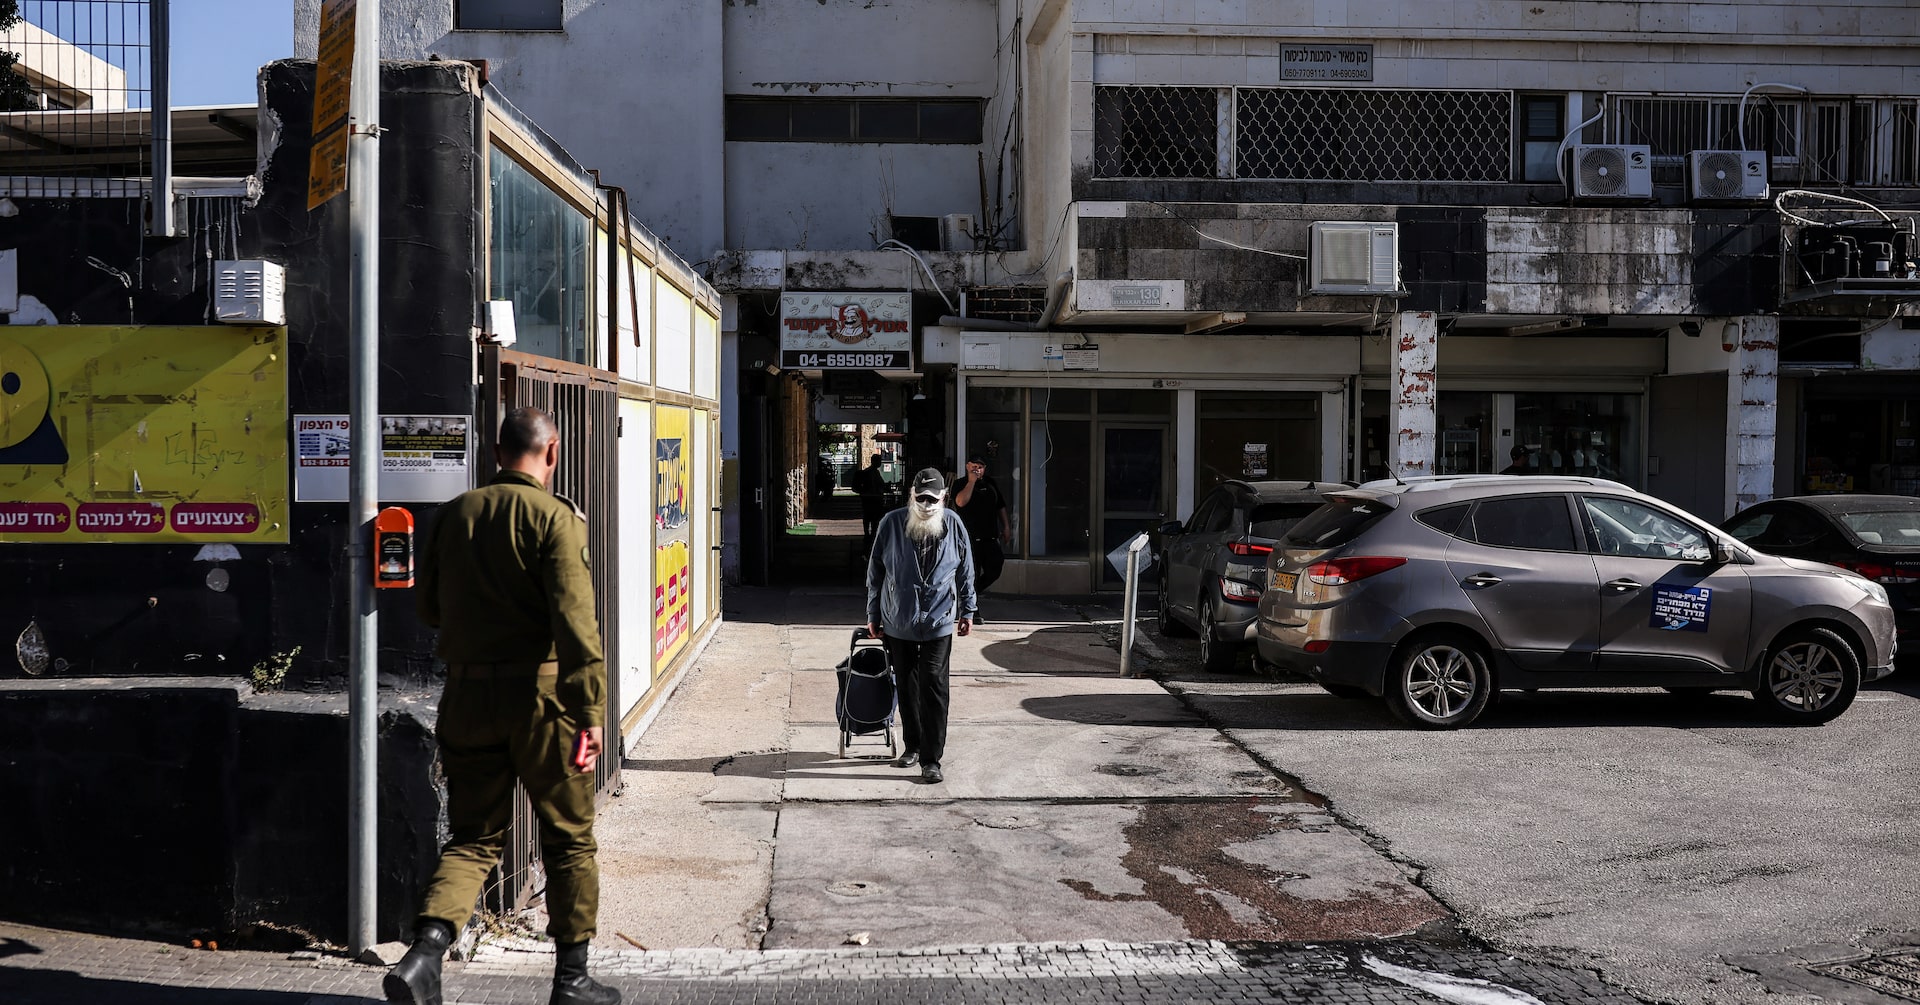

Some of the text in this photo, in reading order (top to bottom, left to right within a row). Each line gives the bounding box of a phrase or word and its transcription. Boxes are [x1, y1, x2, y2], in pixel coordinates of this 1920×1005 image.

[1338, 50, 1355, 62] מאיר
[1356, 51, 1368, 65] כהן
[1284, 68, 1326, 78] 050-7709112
[1140, 288, 1160, 299] 130
[800, 354, 894, 366] 04-6950987
[300, 420, 333, 431] הצפון
[32, 512, 55, 526] חד
[80, 510, 150, 526] כלי כתיבה
[176, 512, 244, 525] צעצועים
